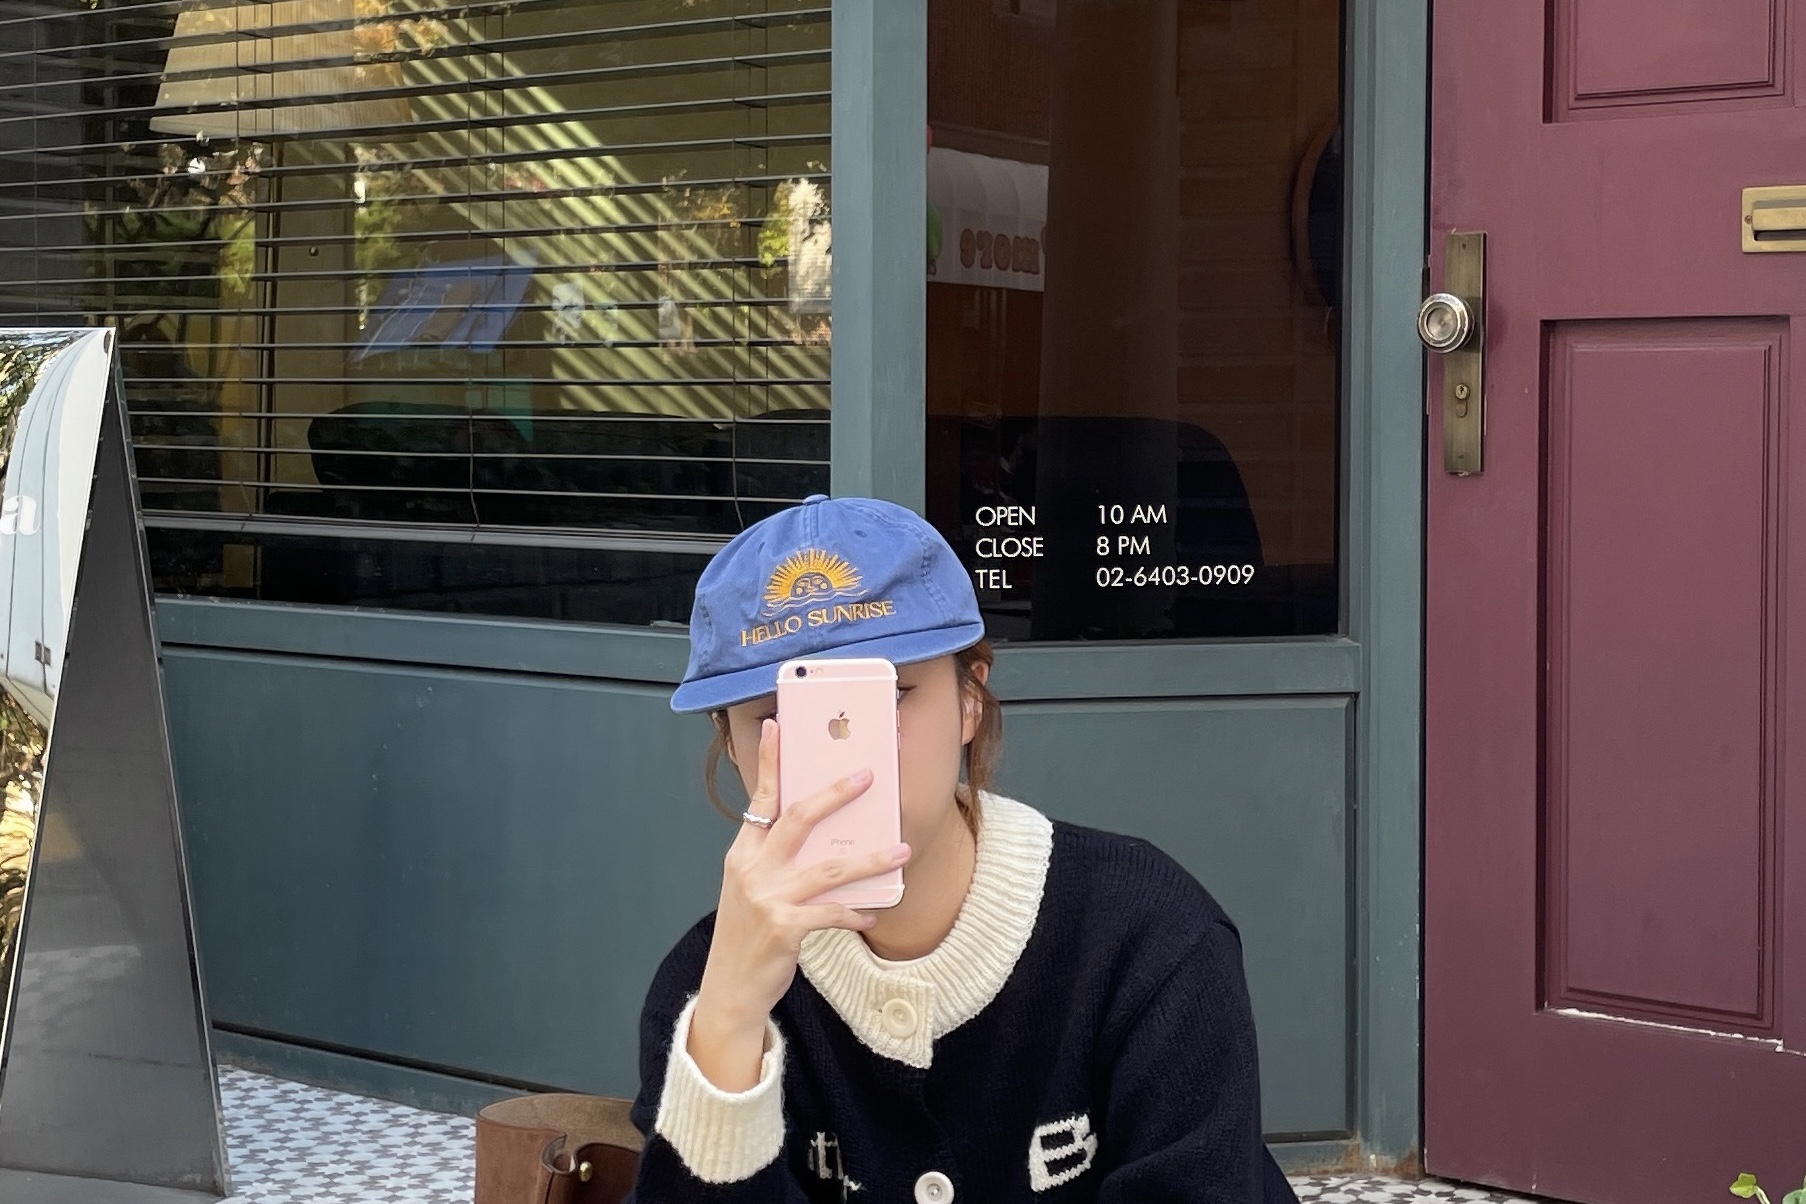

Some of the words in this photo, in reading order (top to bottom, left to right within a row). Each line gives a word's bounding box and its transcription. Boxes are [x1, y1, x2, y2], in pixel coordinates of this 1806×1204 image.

[975, 506, 1036, 527] OPEN
[1097, 504, 1125, 525] 10
[1130, 504, 1168, 524] AM
[975, 537, 1044, 558] CLOSE
[1096, 536, 1110, 556] 8
[1118, 535, 1151, 556] PM
[974, 569, 1012, 589] TEL
[1096, 564, 1255, 588] 02-6403-0909
[740, 616, 802, 646] HELLO
[807, 600, 897, 627] SUNRISE
[830, 838, 855, 847] iPhone
